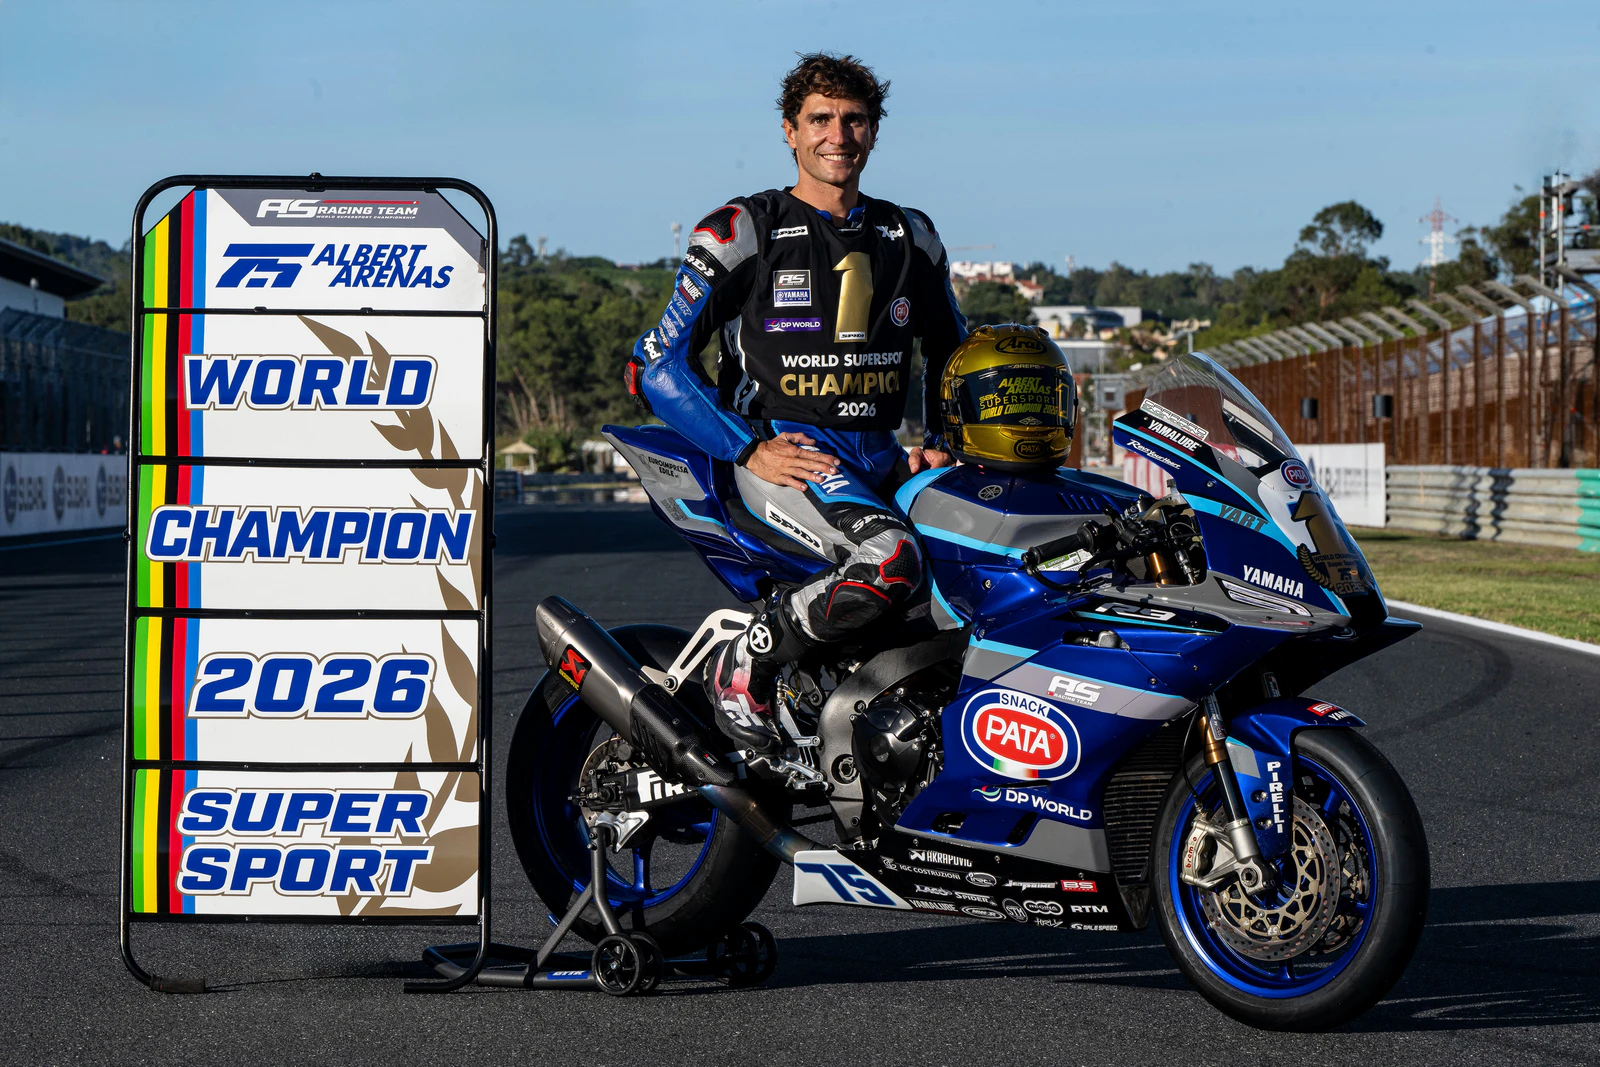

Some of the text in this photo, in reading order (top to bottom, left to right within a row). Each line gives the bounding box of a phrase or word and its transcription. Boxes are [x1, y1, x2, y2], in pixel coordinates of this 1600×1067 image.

[316, 206, 373, 215] RACING
[377, 206, 419, 215] TEAM
[311, 243, 428, 266] ALBERT
[328, 265, 454, 289] ARENAS
[832, 251, 873, 342] 1
[999, 336, 1042, 351] Arai
[781, 354, 839, 368] WORLD
[186, 357, 435, 407] WORLD
[998, 377, 1042, 389] ALBERT
[1005, 384, 1051, 395] ARENAS
[837, 402, 877, 417] 2026
[980, 394, 1056, 410] SUPERSPORT
[980, 405, 1004, 421] WORLD
[1004, 402, 1042, 415] CHAMPION
[1147, 419, 1200, 452] YAMALUBE
[1020, 444, 1041, 454] PATA
[648, 456, 689, 474] EUROIMPRESA
[659, 467, 675, 478] EDILE
[1288, 469, 1308, 480] PATA
[1219, 504, 1270, 532] YART
[148, 508, 475, 560] CHAMPION
[768, 510, 821, 549] SPIDI
[1243, 564, 1304, 599] YAMAHA
[192, 656, 430, 715] 2026
[1001, 693, 1047, 716] SNACK
[1053, 693, 1094, 706] RACING TEAM
[985, 714, 1051, 759] PATA
[1005, 789, 1093, 821] DP WORLD
[1266, 761, 1284, 834] PIRELLI
[180, 791, 428, 833] SUPER
[1185, 836, 1198, 868] bremo
[180, 847, 429, 893] SPORT
[913, 867, 961, 880] COSTRUZIONI
[794, 863, 898, 907] 75
[1063, 881, 1094, 889] BS
[909, 899, 959, 912] YAMALUBE
[953, 891, 990, 904] SPIDER
[1070, 905, 1109, 913] RTM
